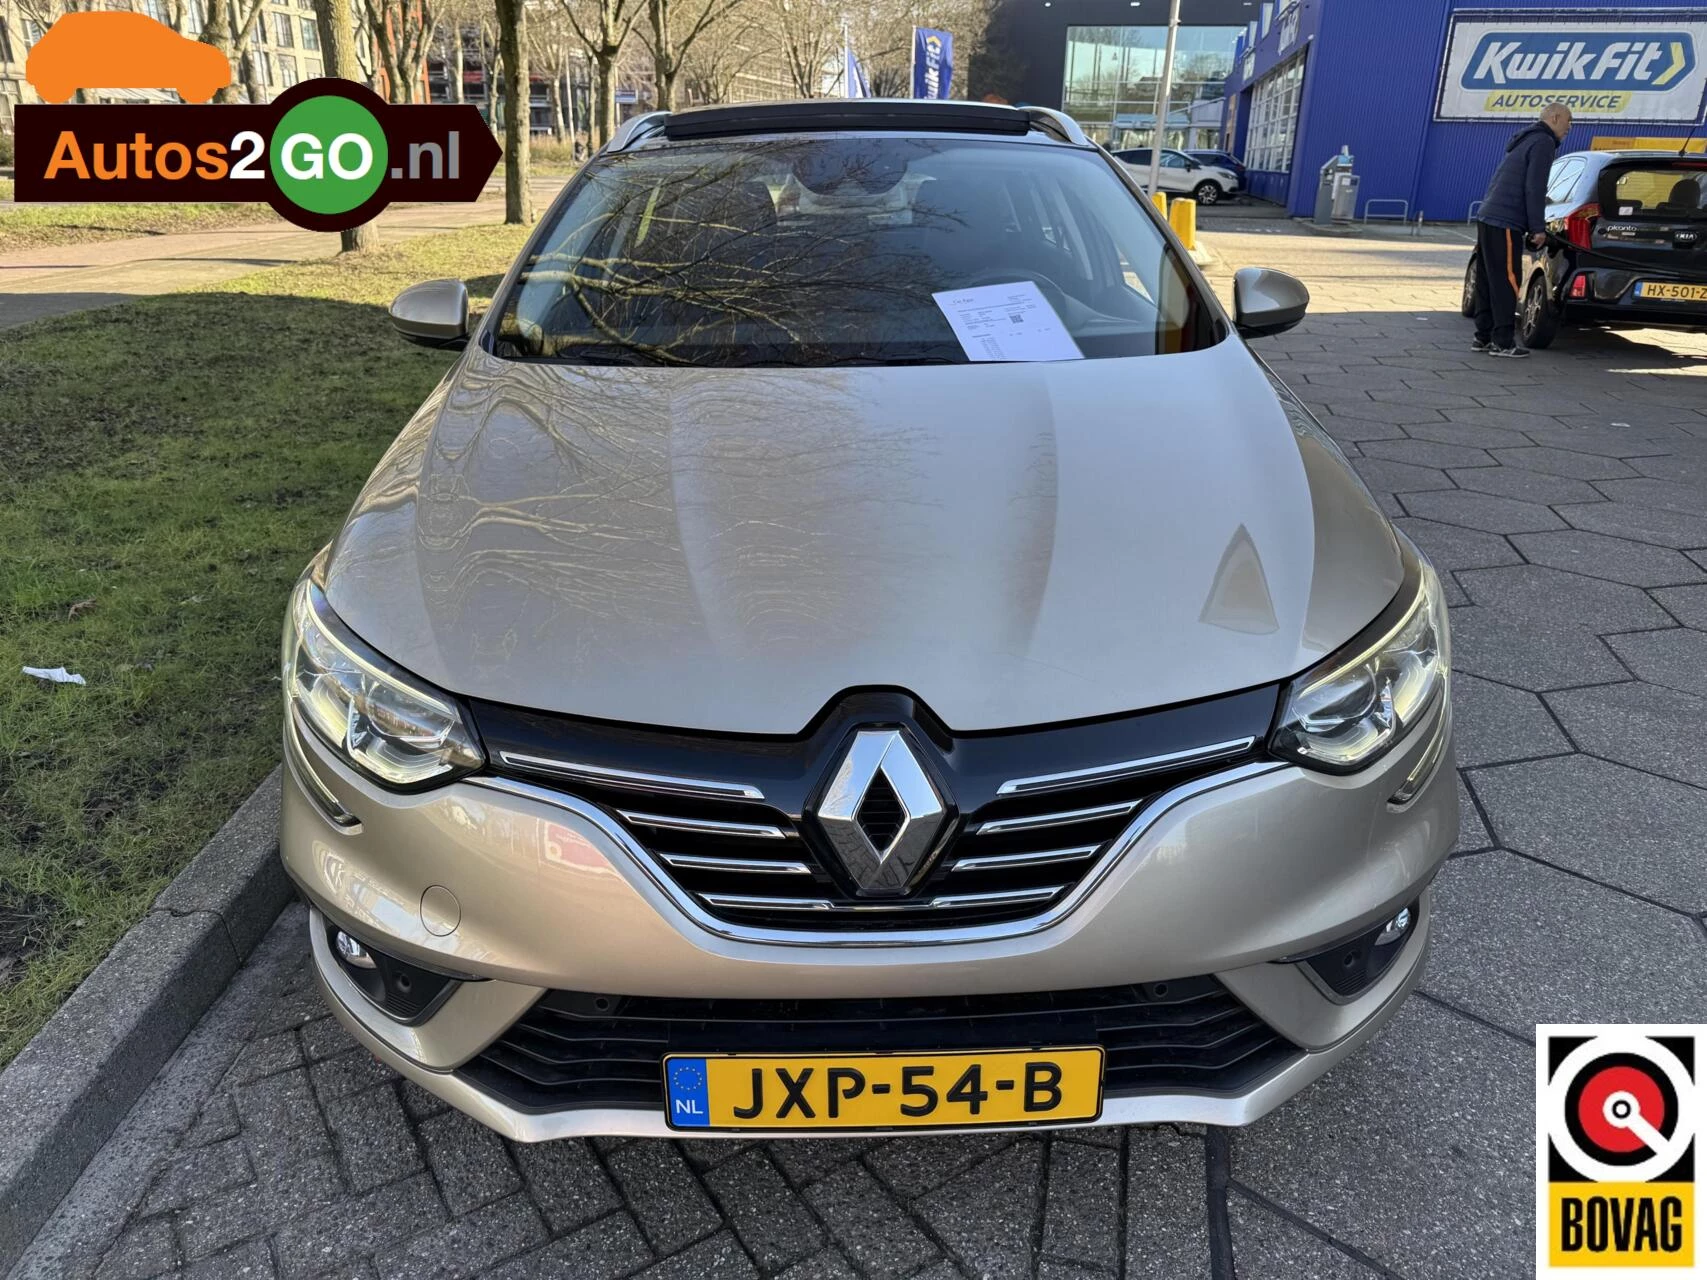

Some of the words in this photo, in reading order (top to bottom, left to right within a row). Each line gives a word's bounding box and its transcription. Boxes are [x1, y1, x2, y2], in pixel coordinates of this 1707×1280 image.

[1647, 284, 1707, 299] HX-501-Z
[733, 1062, 1062, 1119] JXP-54-B
[676, 1100, 703, 1115] NL
